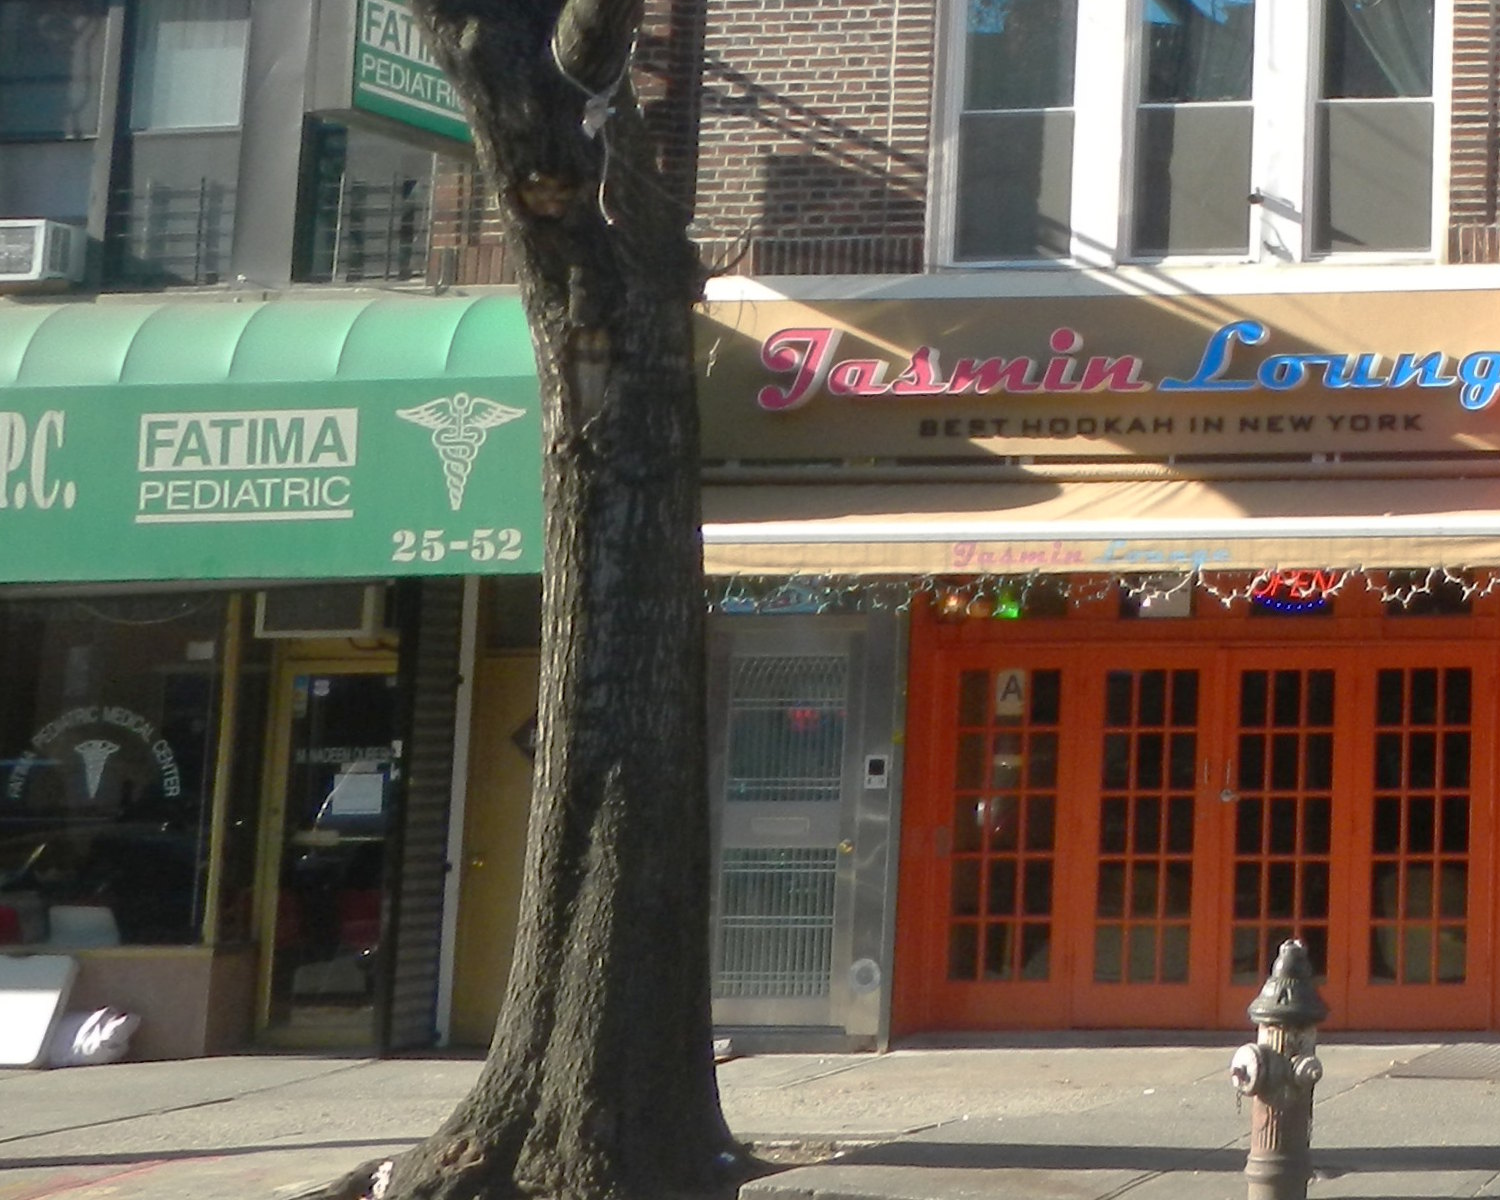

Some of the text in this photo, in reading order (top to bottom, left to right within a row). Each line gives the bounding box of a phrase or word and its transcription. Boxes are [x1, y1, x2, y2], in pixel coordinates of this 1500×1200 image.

[758, 326, 1152, 411] Jasmin
[146, 416, 348, 467] FATIMA
[920, 413, 1425, 438] BEST HOOKAH IN NEW YORK
[0, 410, 77, 510] P.C.
[139, 476, 351, 510] PEDIATRIC
[391, 528, 523, 562] 25-52
[951, 540, 1231, 569] Jasmin Lounge
[1001, 675, 1022, 702] A
[103, 706, 154, 742] MEDICAL
[153, 739, 181, 797] CENTER
